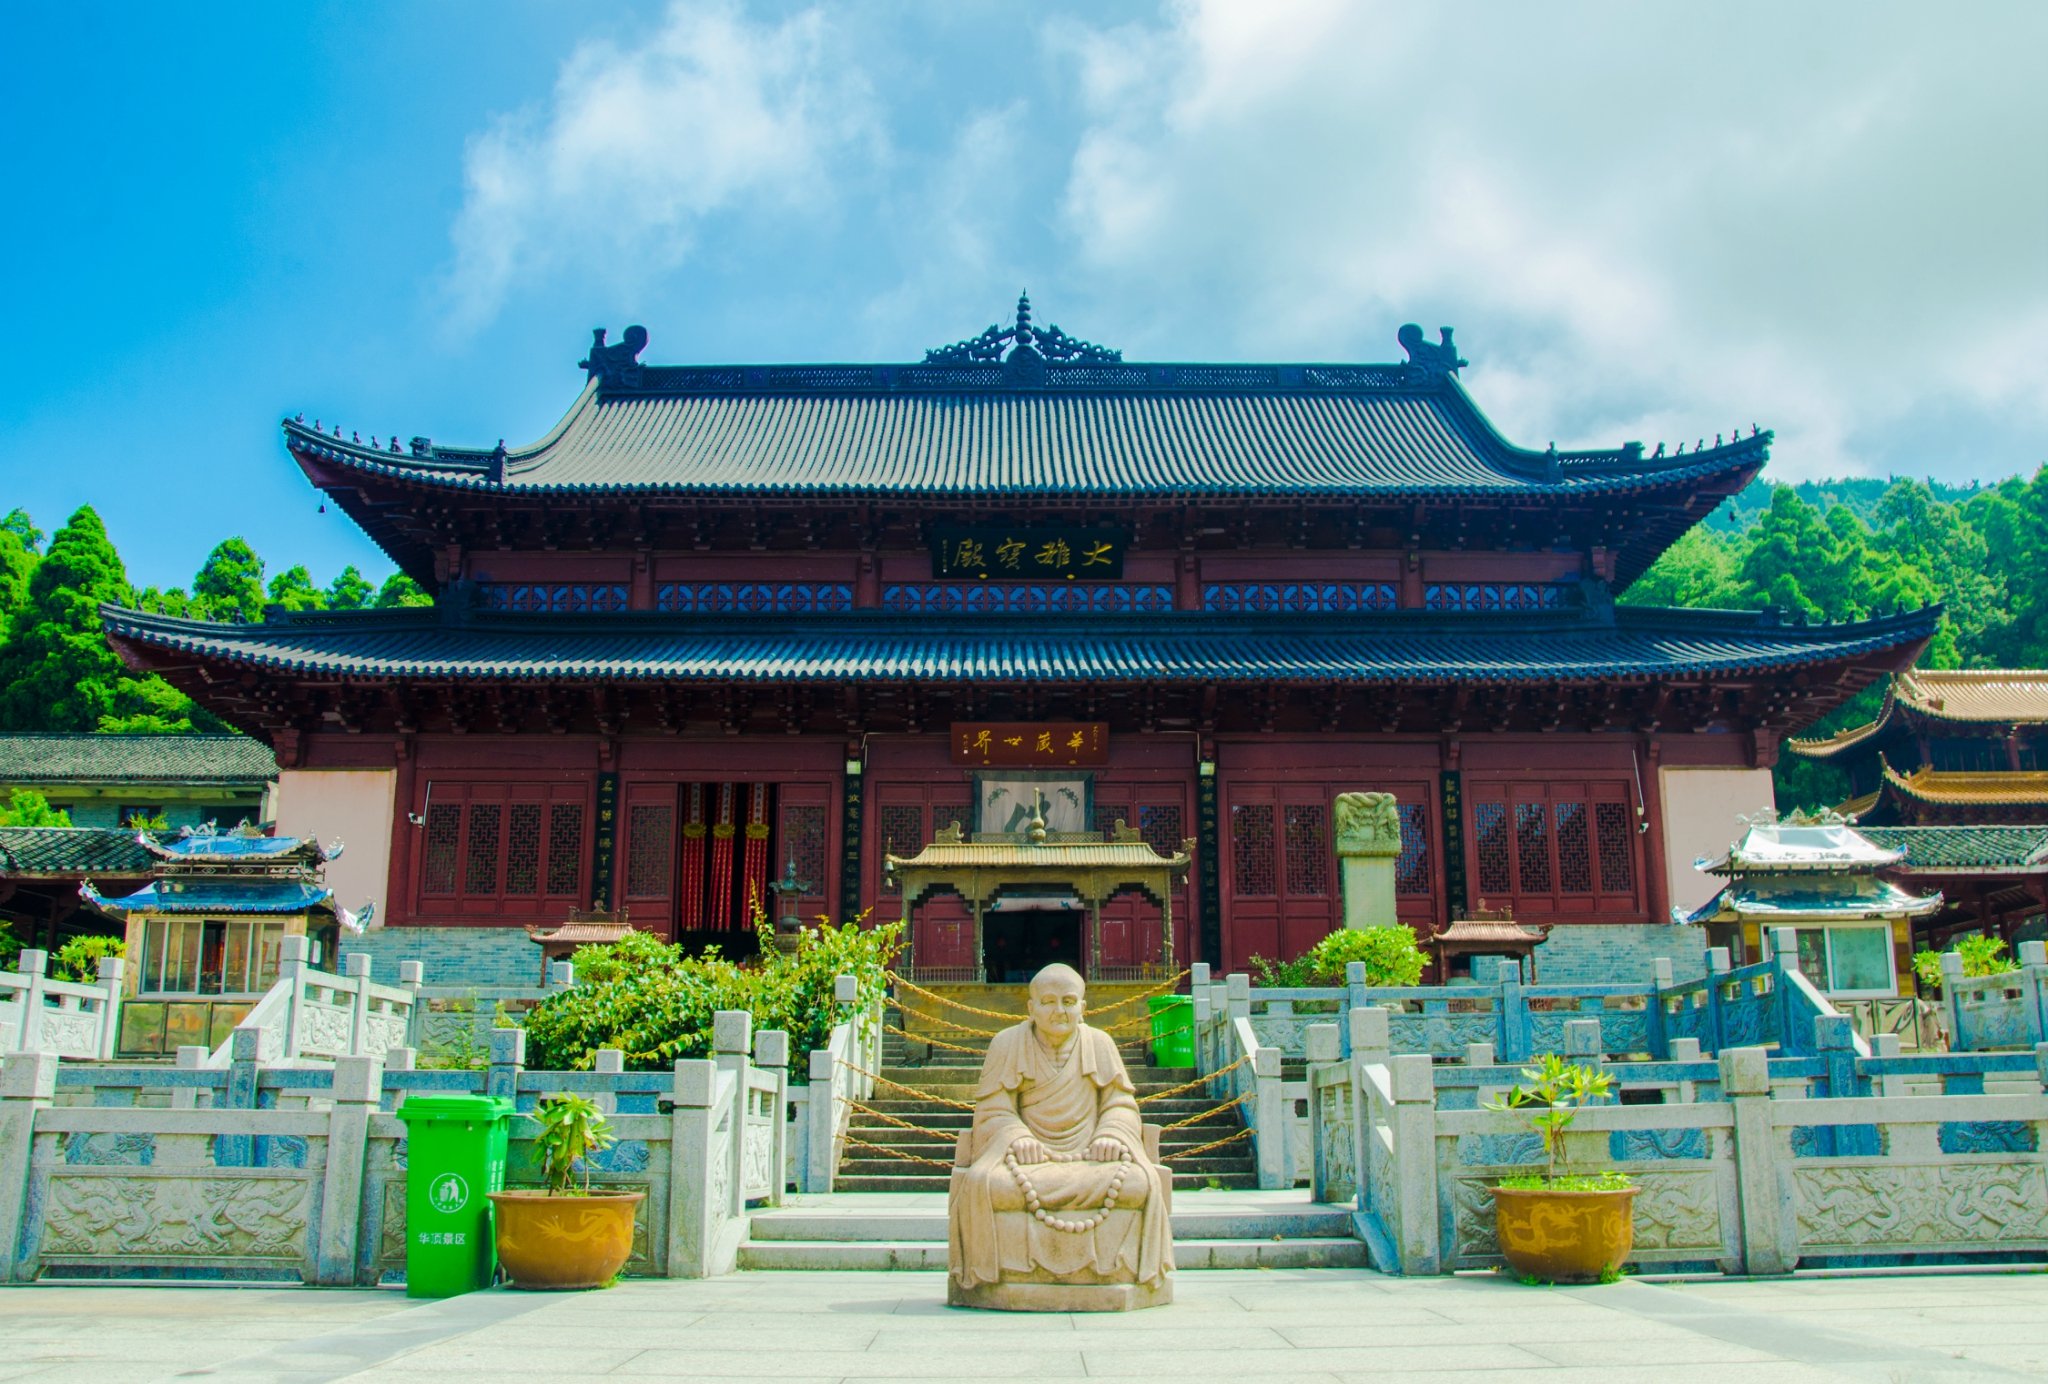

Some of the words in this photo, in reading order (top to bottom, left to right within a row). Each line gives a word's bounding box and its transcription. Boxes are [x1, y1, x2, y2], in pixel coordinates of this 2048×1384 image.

[953, 537, 1113, 570] 大雄寶殿
[418, 1232, 466, 1245] 华顶景区
